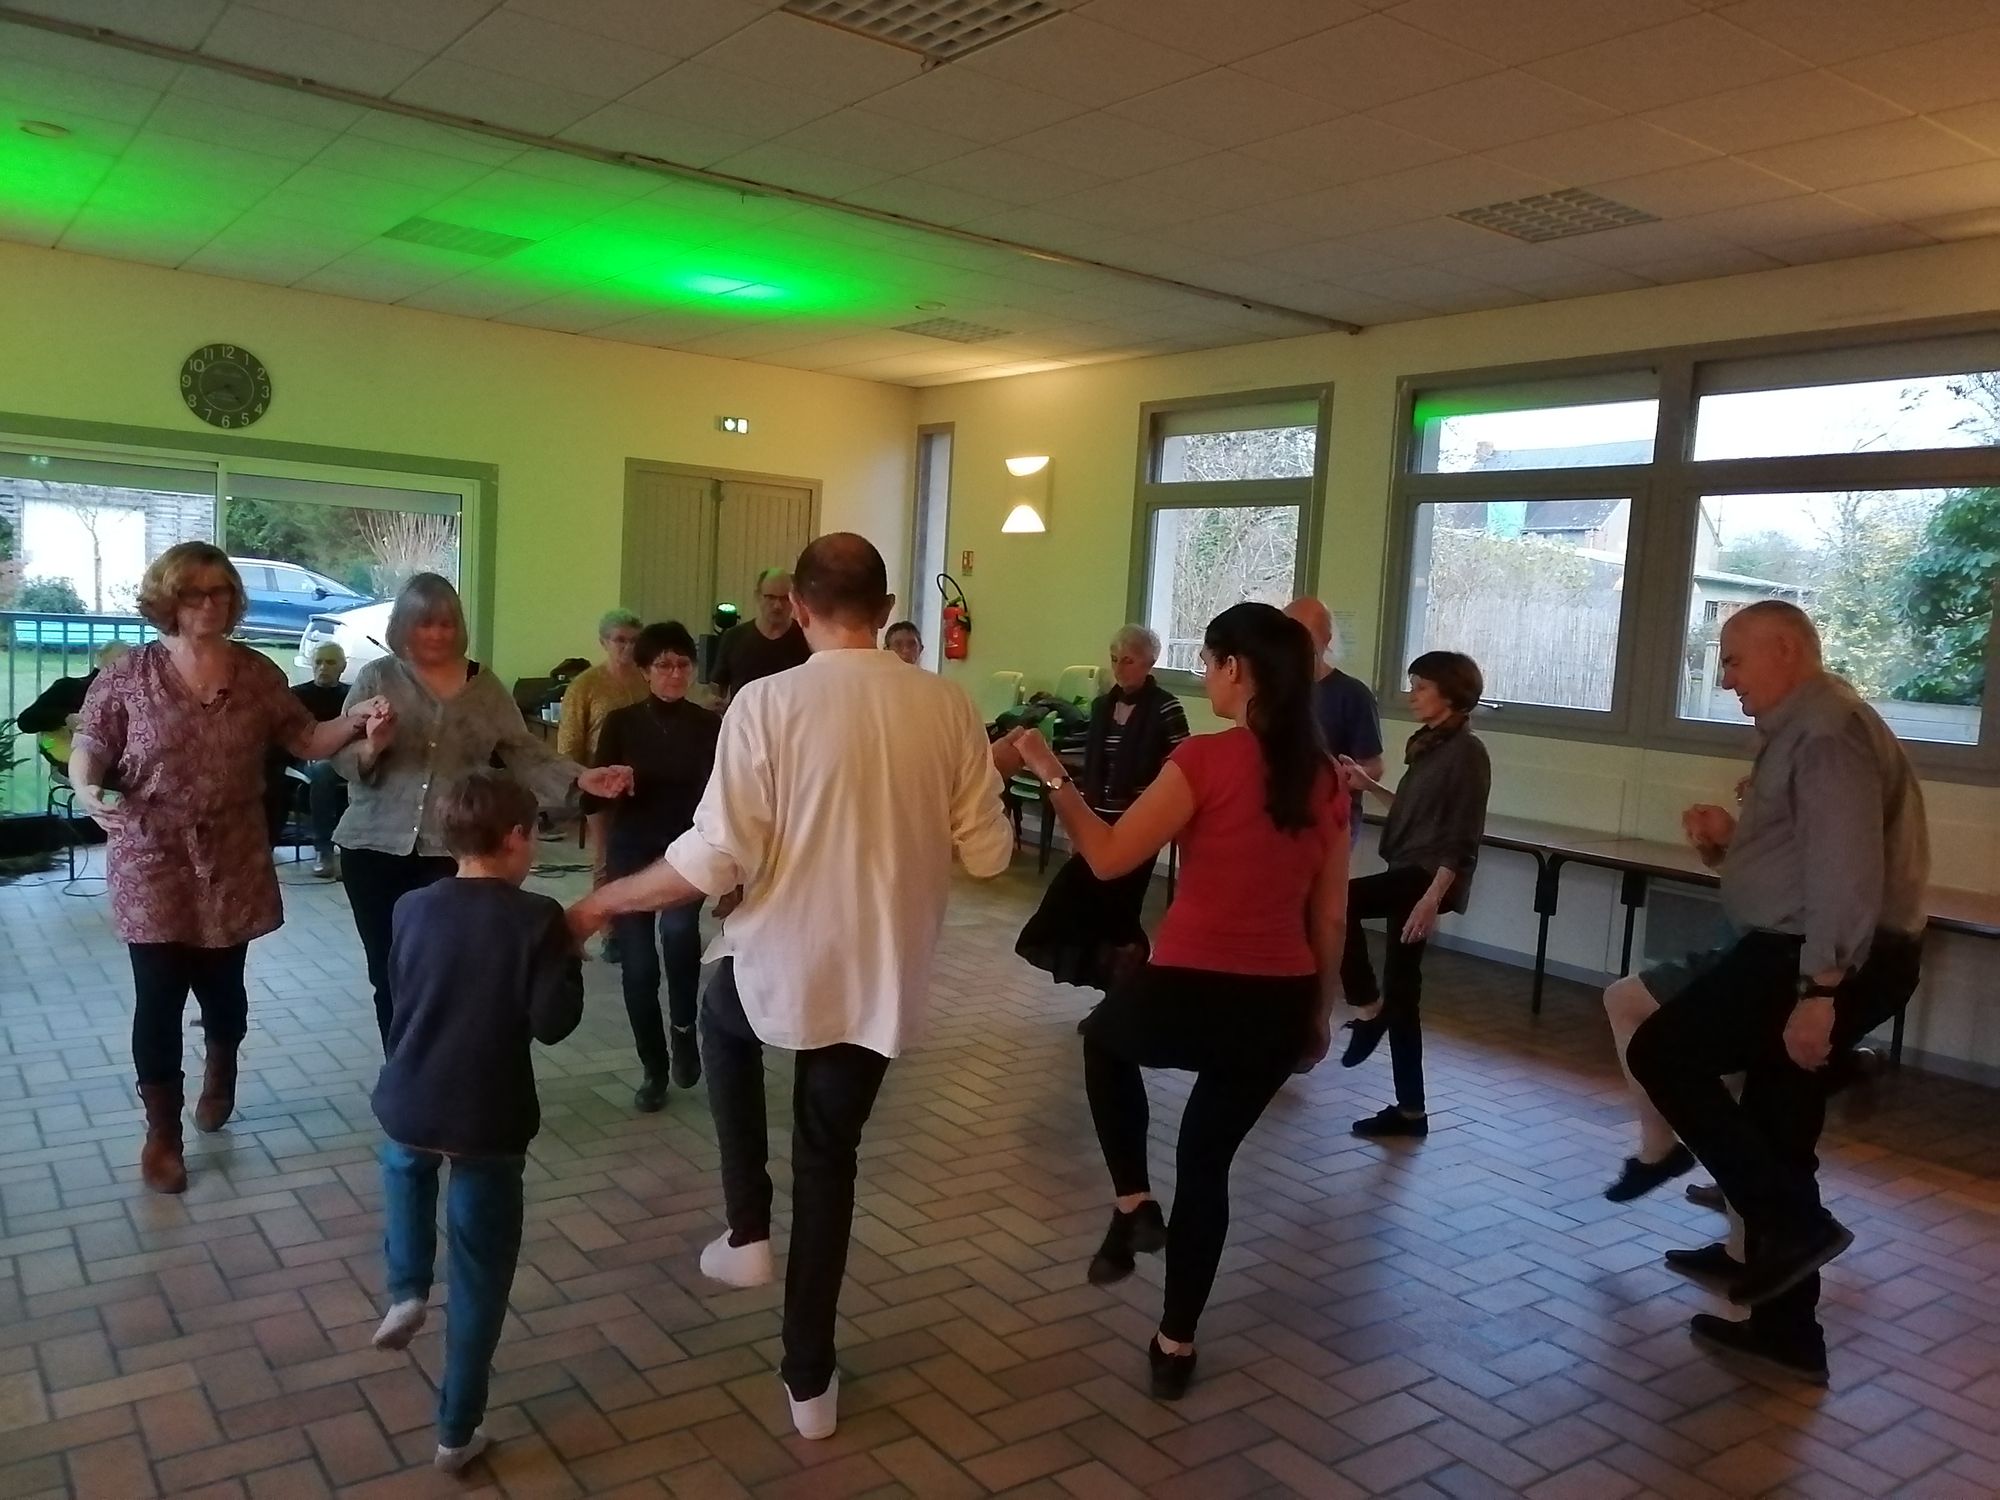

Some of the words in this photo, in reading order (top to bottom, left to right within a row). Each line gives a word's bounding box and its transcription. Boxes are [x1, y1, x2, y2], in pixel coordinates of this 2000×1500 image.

[203, 348, 214, 360] 11
[222, 345, 235, 359] 12
[188, 359, 205, 373] 10
[245, 353, 249, 366] 1
[257, 367, 265, 380] 2
[182, 374, 191, 388] 9
[261, 385, 270, 399] 3
[188, 394, 197, 408] 8
[204, 408, 212, 421] 7
[254, 402, 263, 415] 4
[221, 415, 230, 428] 6
[241, 412, 249, 425] 5
